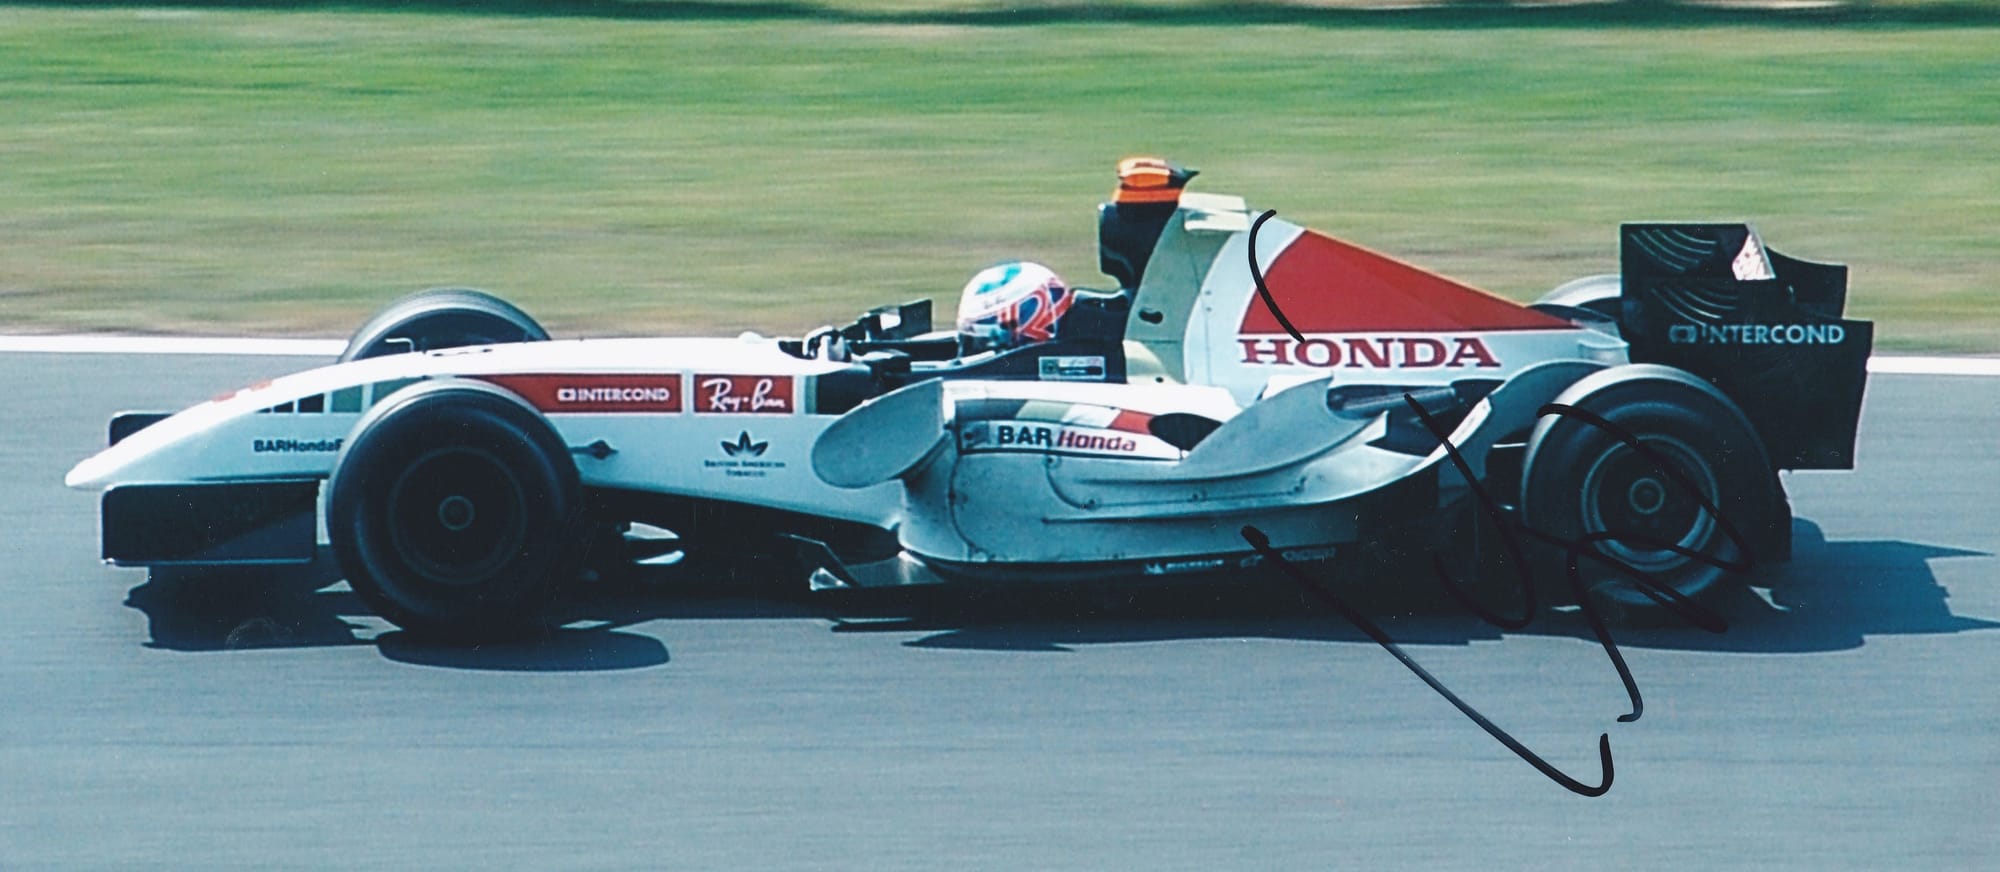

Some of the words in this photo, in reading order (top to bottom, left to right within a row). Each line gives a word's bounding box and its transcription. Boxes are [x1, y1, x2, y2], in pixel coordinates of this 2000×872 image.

[1238, 337, 1501, 368] HONDA
[578, 387, 670, 401] INTERCOND
[997, 425, 1053, 446] BAR
[1056, 429, 1137, 452] Honda
